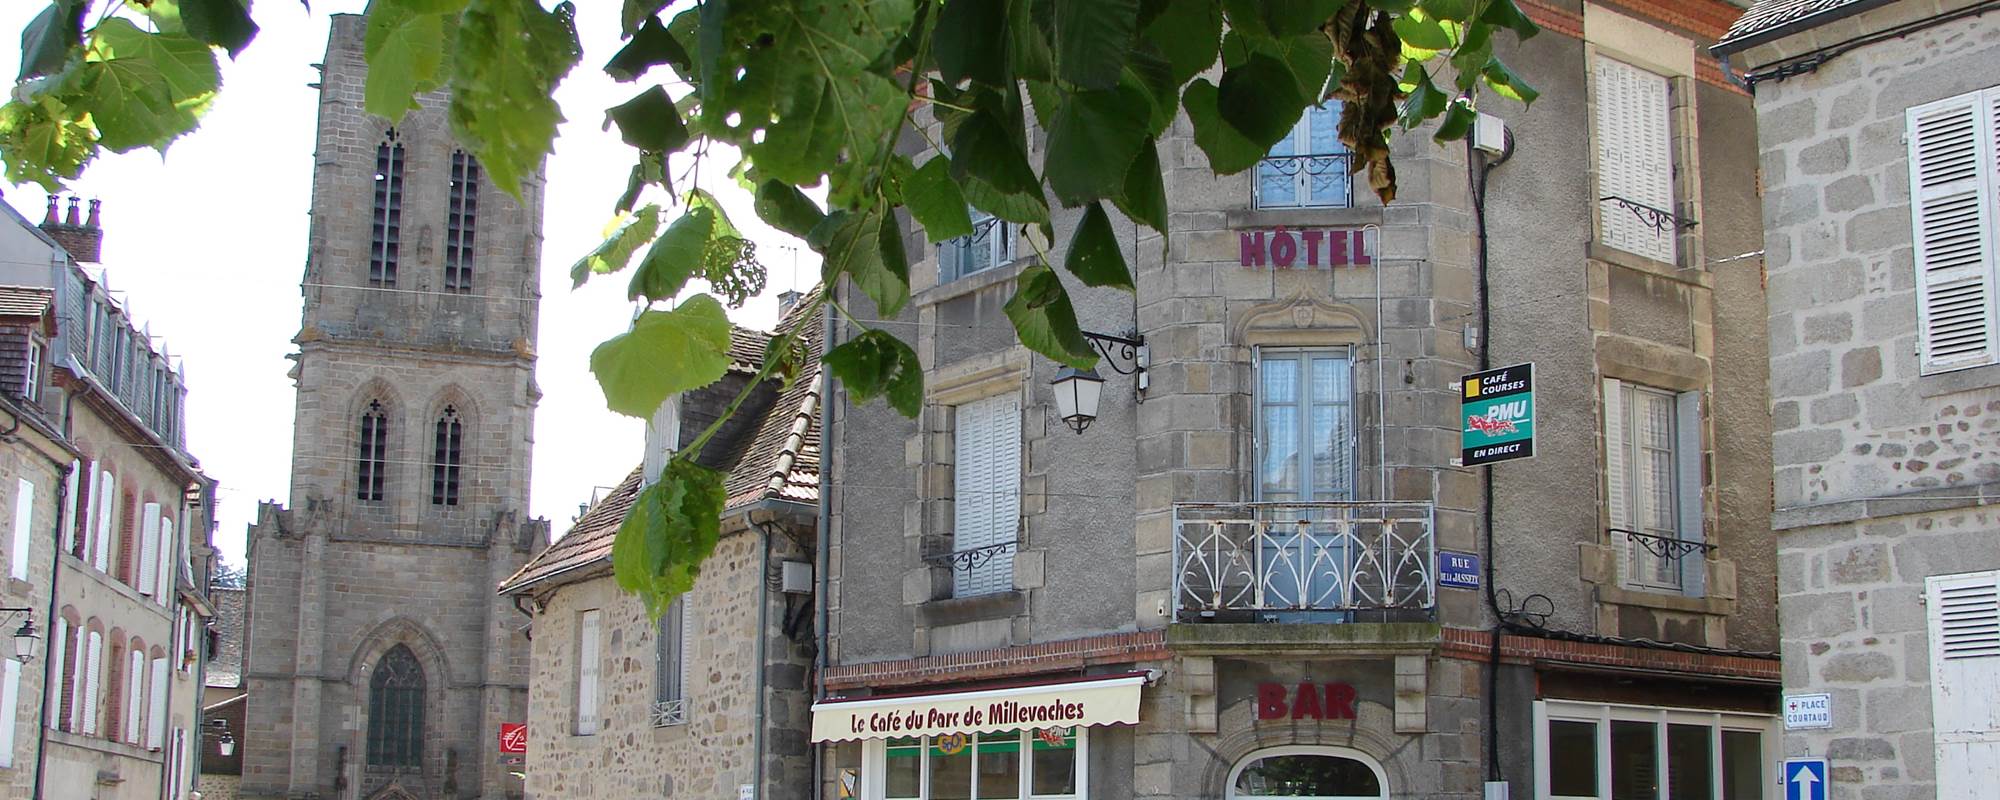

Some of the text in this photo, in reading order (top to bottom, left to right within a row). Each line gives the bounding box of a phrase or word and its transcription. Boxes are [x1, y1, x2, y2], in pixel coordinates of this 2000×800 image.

[1240, 225, 1371, 267] HÔTEL
[1483, 370, 1508, 385] CAFÉ
[1482, 380, 1525, 395] COURSES
[1486, 400, 1527, 422] PMU
[1473, 443, 1521, 458] EN DIRECT
[1451, 557, 1470, 569] RUE
[1258, 681, 1357, 720] BAR
[1801, 700, 1825, 709] PLACE
[851, 699, 1084, 733] Le Café du Parc de Millevaches
[1787, 713, 1827, 722] COURTAUD
